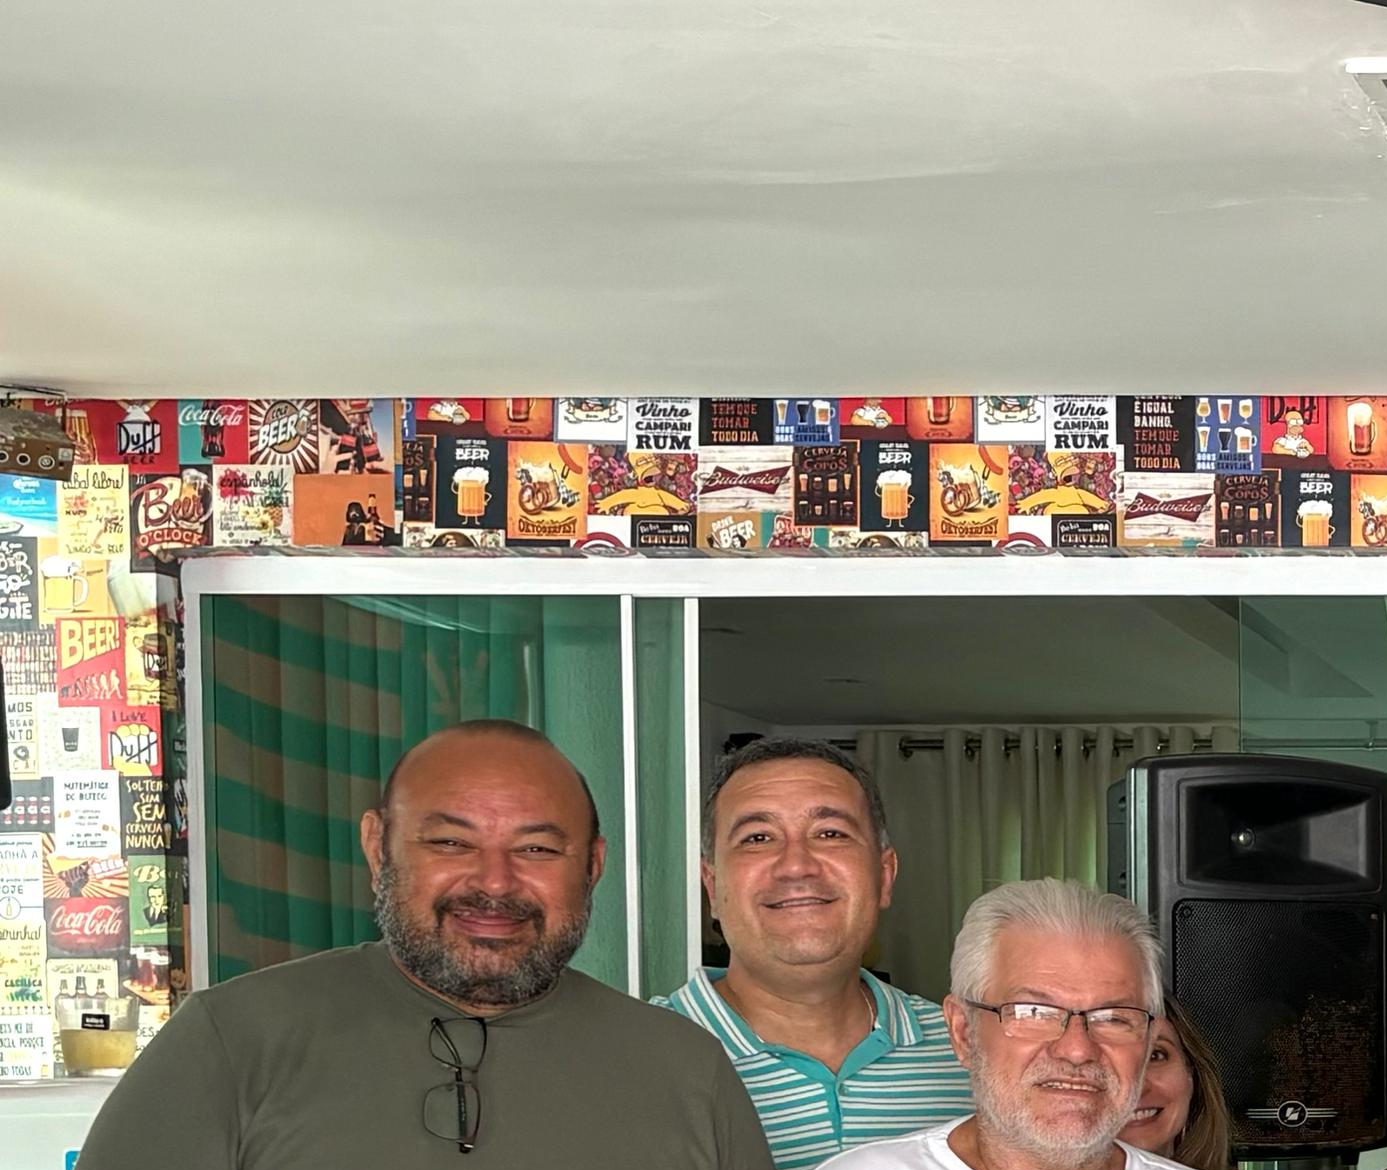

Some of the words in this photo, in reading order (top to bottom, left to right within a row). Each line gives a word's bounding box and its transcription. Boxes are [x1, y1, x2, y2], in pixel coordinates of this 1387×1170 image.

[635, 421, 691, 432] CAMPARI
[1053, 420, 1109, 432] CAMPARI
[635, 435, 692, 450] RUM
[1054, 434, 1109, 449] RUM
